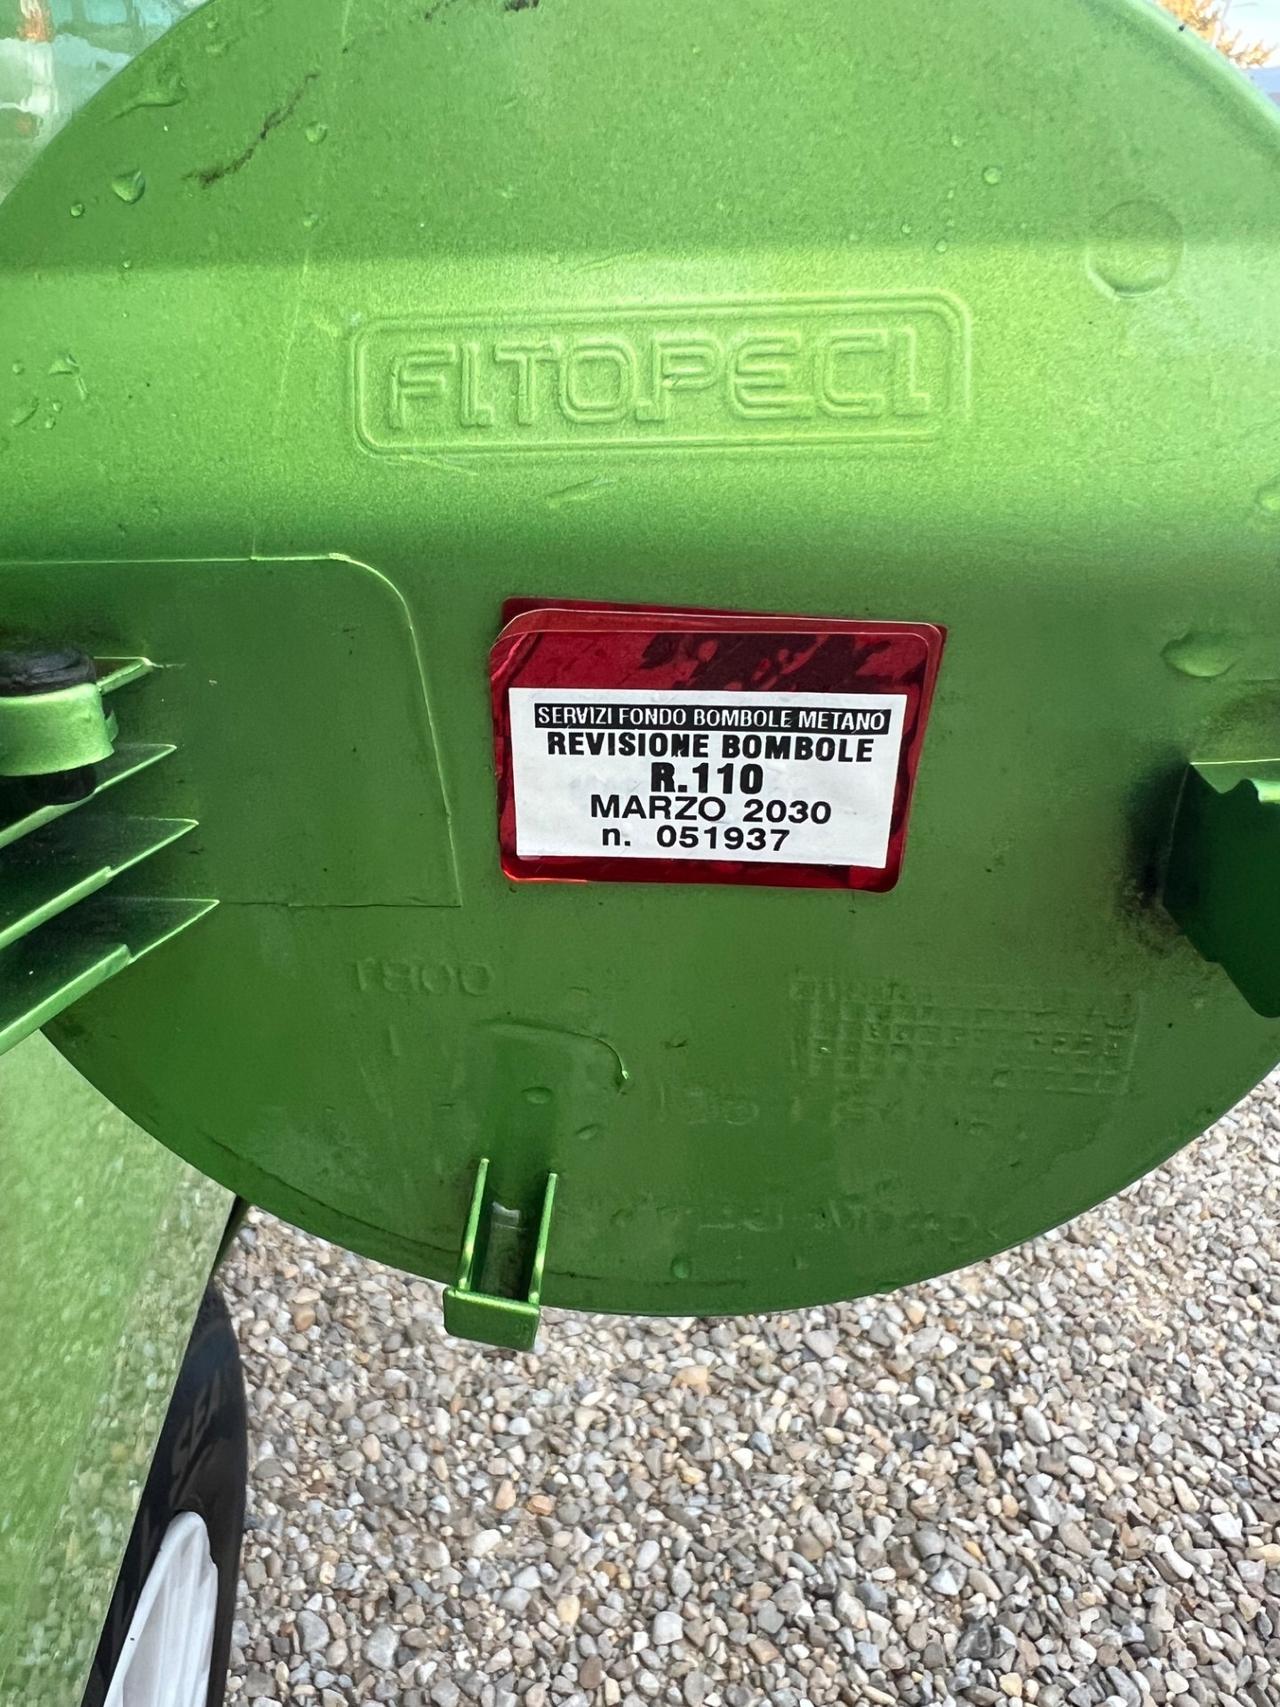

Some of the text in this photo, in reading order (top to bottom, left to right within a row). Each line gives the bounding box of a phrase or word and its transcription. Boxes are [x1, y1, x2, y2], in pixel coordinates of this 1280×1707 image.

[538, 706, 885, 730] SERVIZI FONDO BOMBOLE METANO
[547, 732, 874, 762] REVISIONE BOMBOLE
[651, 762, 763, 794] R.110
[591, 794, 831, 824] MARZO 2030
[602, 825, 790, 851] n. 051937
